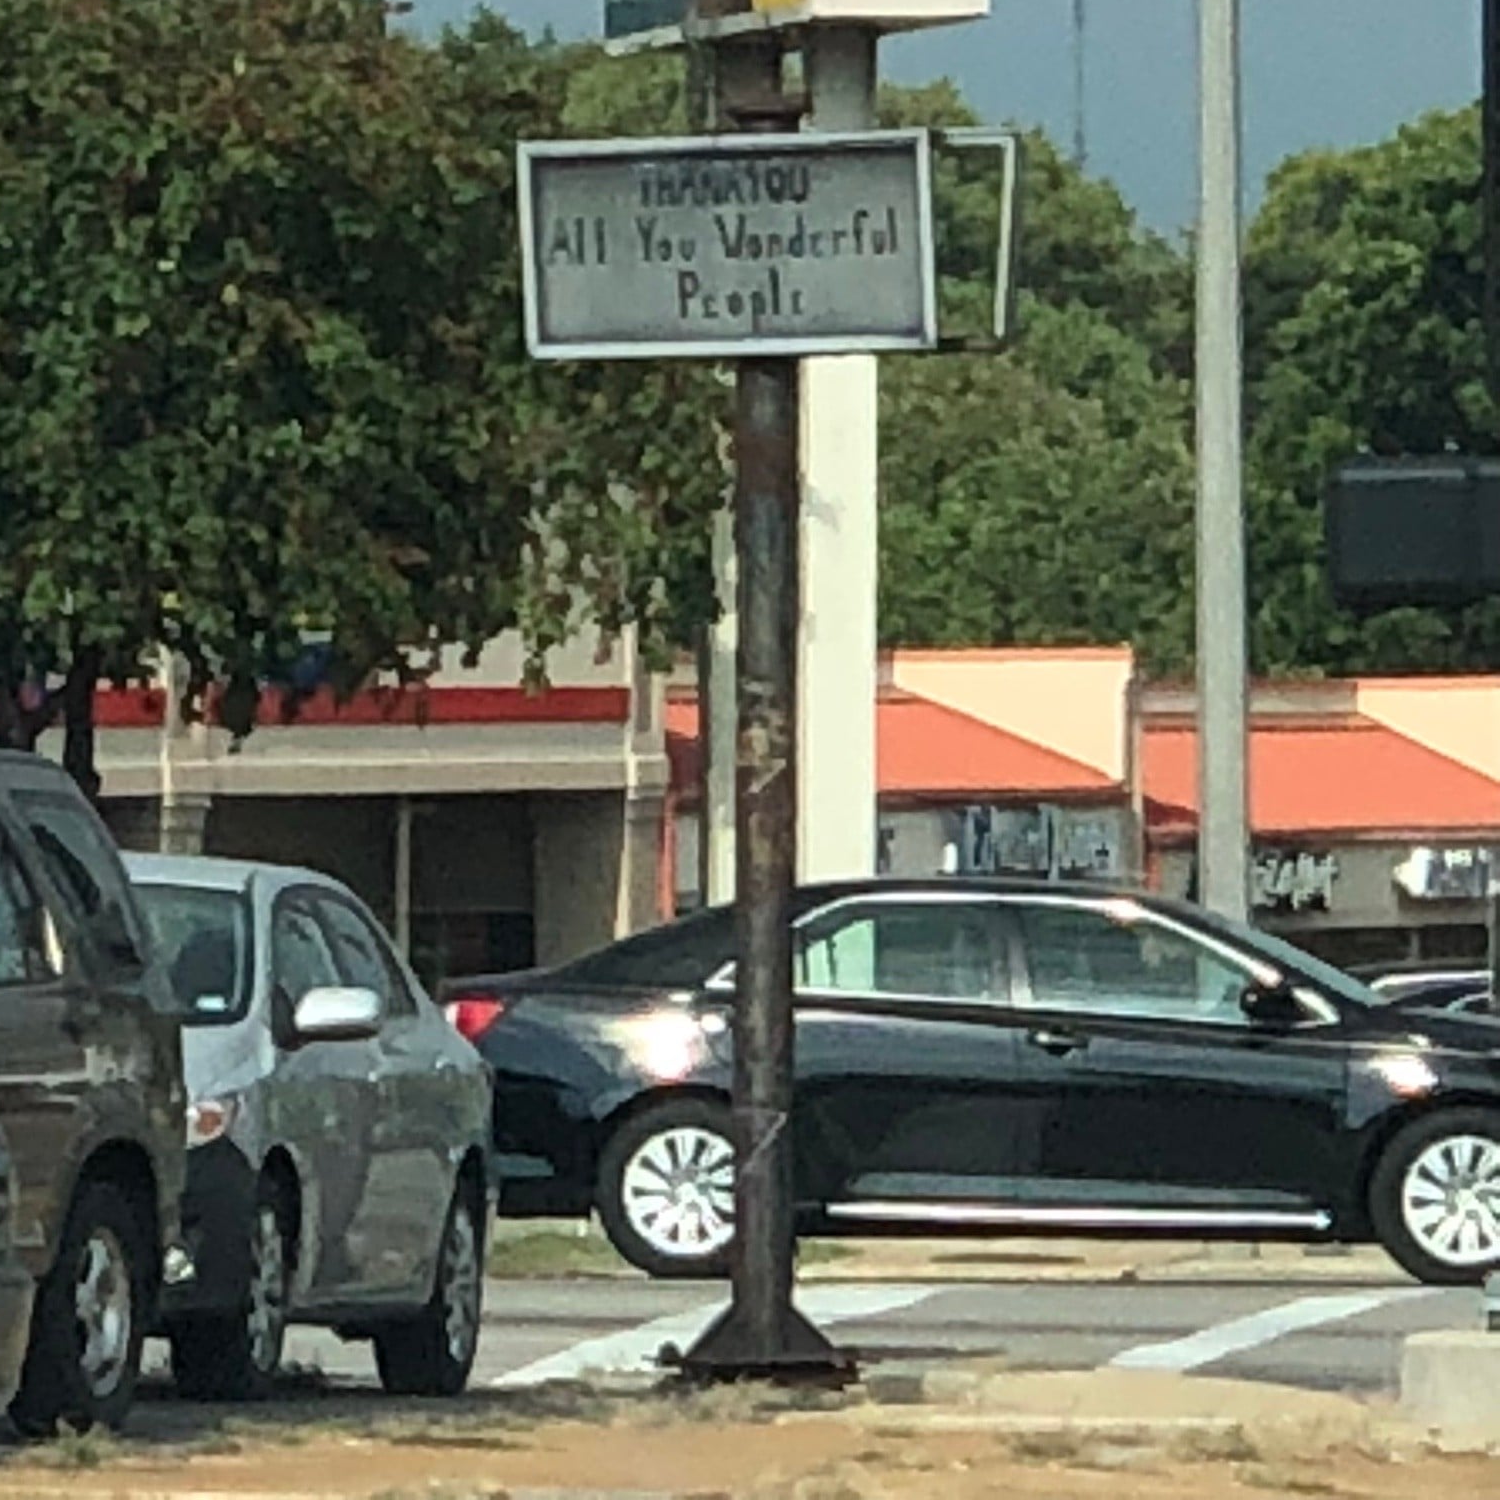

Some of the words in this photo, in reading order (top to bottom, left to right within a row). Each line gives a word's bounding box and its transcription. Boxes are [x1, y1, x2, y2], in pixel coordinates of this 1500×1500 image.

[547, 216, 606, 266] All
[634, 215, 696, 263] You
[713, 206, 899, 260] Wonderful
[678, 266, 804, 333] People
